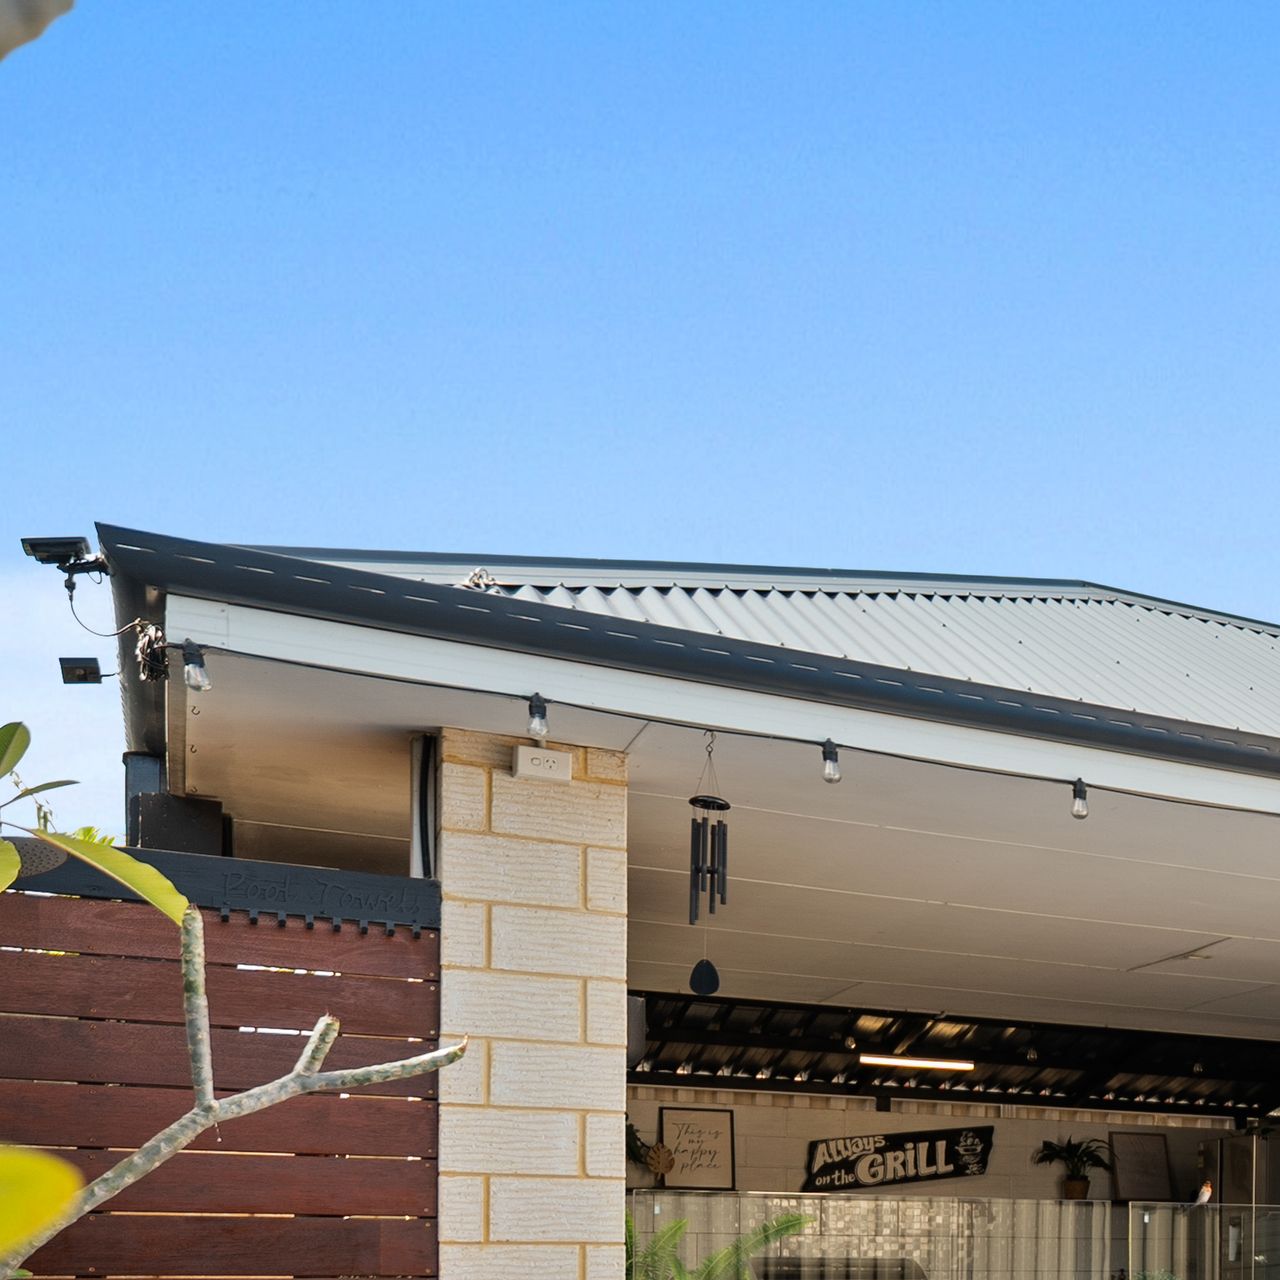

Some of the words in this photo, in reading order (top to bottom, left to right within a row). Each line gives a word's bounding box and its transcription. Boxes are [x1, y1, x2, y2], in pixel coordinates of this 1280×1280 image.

[671, 1122, 705, 1140] This
[707, 1129, 723, 1140] is
[673, 1142, 720, 1163] happy
[680, 1157, 721, 1176] place
[815, 1177, 831, 1186] on
[831, 1171, 855, 1185] the
